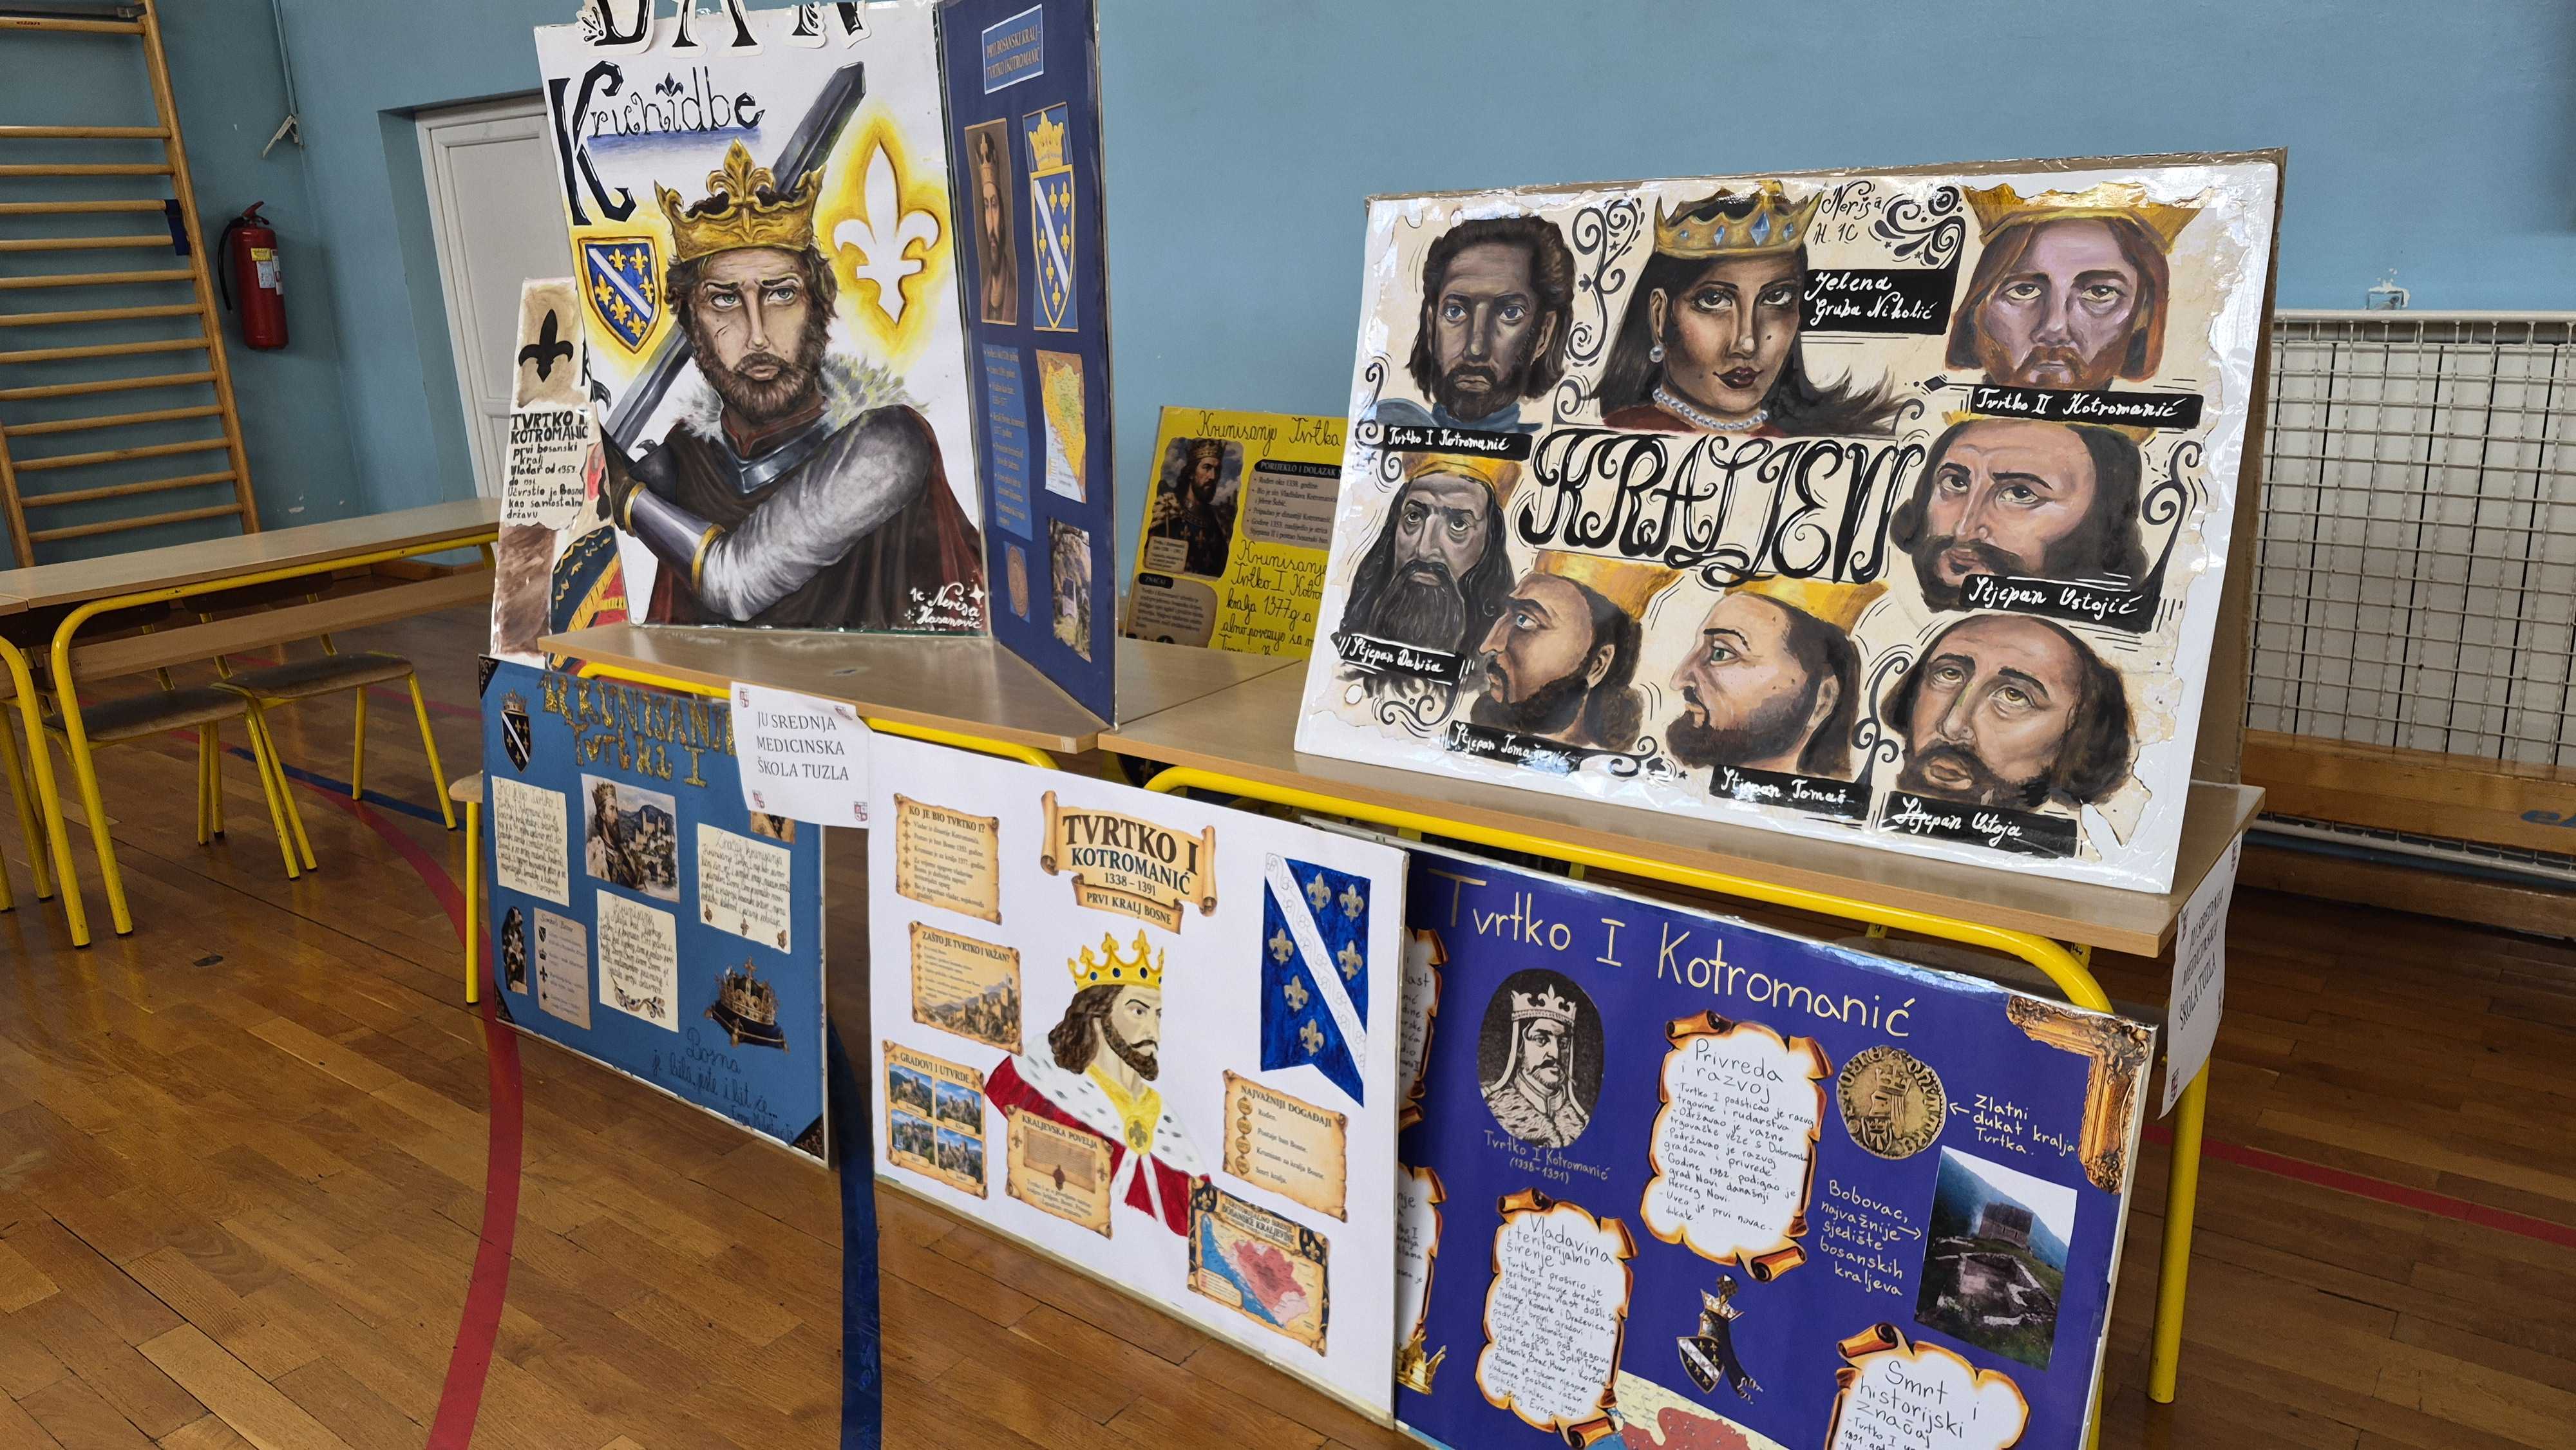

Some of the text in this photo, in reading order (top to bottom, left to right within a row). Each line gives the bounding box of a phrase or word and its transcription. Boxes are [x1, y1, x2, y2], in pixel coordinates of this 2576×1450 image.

[1804, 272, 1891, 301] Jelena
[1810, 298, 1861, 326] Gruba
[1976, 388, 2187, 417] Tvrtko II Kotromanić
[511, 411, 573, 430] TVRTKO
[1196, 410, 1340, 457] Krunisanje Tvrtka
[513, 442, 577, 460] prvi bosanski
[1388, 427, 1510, 451] Tvrtko I Kotromanić
[520, 455, 543, 465] kralj
[545, 463, 555, 473] od
[1260, 462, 1297, 472] PORIJEKLO
[1303, 466, 1335, 476] DOLAZAK
[509, 476, 518, 486] do
[550, 487, 557, 501] je
[506, 509, 538, 519] državu
[509, 499, 524, 509] kao
[1271, 569, 1287, 592] I
[1969, 576, 2047, 608] Stjepan
[917, 605, 983, 628] Hasanović
[1226, 588, 1256, 625] kralja
[1349, 636, 1444, 672] Stjepan Dabiša
[758, 711, 837, 733] JU SREDNJA
[757, 735, 845, 755] MEDICINSKA
[684, 745, 707, 787] I
[757, 756, 849, 780] ŠKOLA TUZLA
[1792, 779, 1846, 803] Tomaš
[909, 806, 985, 833] KO JE BIO TVRTKO I?
[1063, 814, 1198, 876] TVRTKO I
[1072, 848, 1190, 895] KOTROMANIĆ
[1105, 872, 1156, 896] 1338 1391
[1087, 892, 1172, 925] PRVI KRALJ BOSNE
[2197, 886, 2224, 938] SREDNJA
[922, 932, 943, 944] ZAŠTO
[945, 937, 952, 947] JE
[953, 940, 980, 954] TVRTKO
[985, 949, 1010, 963] VAŽAN?
[1427, 868, 1916, 1037] Tvrtko I Kotromanić
[2179, 952, 2216, 1030] ŠKOLA TUZLA
[686, 1027, 741, 1074] Bosna
[1696, 1038, 1783, 1082] Privreda
[900, 1053, 969, 1082] GRADOVI I UTVRDE
[1241, 1085, 1285, 1109] NAJVAŽNIJI
[1681, 1061, 1770, 1104] i razvoj
[1676, 1094, 1716, 1113] trgovine
[1713, 1092, 1719, 1102] I
[1725, 1097, 1769, 1113] podsticao
[1774, 1109, 1785, 1119] je
[1973, 1093, 2029, 1120] Zlatni
[1022, 1115, 1097, 1149] KRALJEVSKA POVELJA
[1671, 1116, 1718, 1137] trgovačke
[1726, 1133, 1748, 1145] veze
[1732, 1120, 1741, 1133] je
[1973, 1111, 2075, 1156] dukat kralja
[1484, 1130, 1610, 1180] Tvrtko I Kotromanić
[1664, 1141, 1705, 1157] gradova
[1670, 1127, 1719, 1150] Podržavao
[1726, 1144, 1735, 1156] je
[1668, 1153, 1700, 1171] Godine
[1785, 1188, 1796, 1198] je
[1669, 1168, 1769, 1204] grad Novi današnji
[1669, 1178, 1700, 1200] Herceg
[1667, 1191, 1731, 1220] Uveo je prvi
[1828, 1180, 1908, 1223] Bobovac,
[1821, 1200, 1900, 1241] najvažnije
[1515, 1225, 1590, 1266] teritorijalno
[1530, 1213, 1614, 1265] Vladavina
[1823, 1221, 1884, 1251] sjedište
[1820, 1236, 1903, 1279] bosanskih
[1593, 1285, 1603, 1298] je
[1834, 1261, 1903, 1296] kraljeva
[1861, 1375, 1963, 1438] historijski
[1973, 1402, 1980, 1420] i
[1855, 1417, 1883, 1439] Tvrtko
[1888, 1435, 1896, 1447] I
